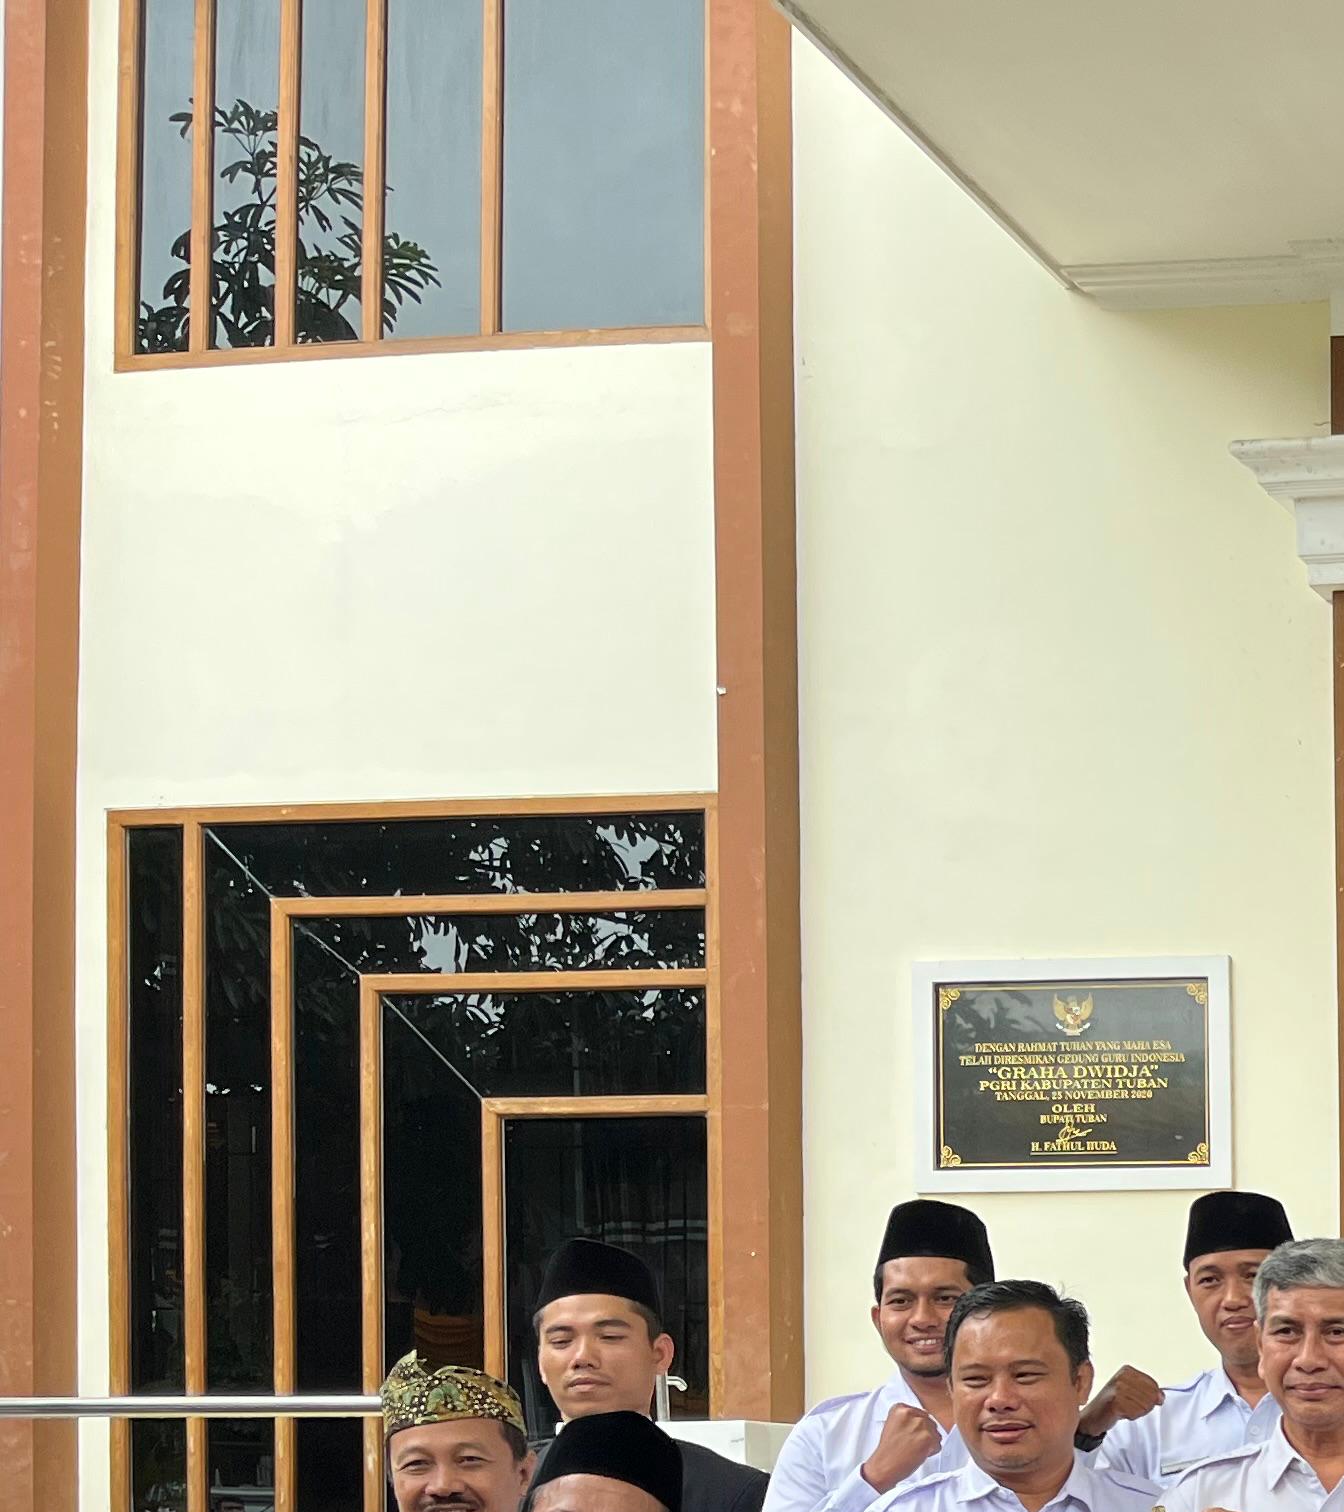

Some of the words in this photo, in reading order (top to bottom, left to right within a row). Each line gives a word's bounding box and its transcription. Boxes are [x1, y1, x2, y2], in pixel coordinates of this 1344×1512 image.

[975, 1043, 1015, 1053] DENGAN
[1018, 1042, 1057, 1052] RAHMAT
[1060, 1042, 1093, 1051] TUHAN
[1095, 1041, 1120, 1051] YANG
[1123, 1041, 1150, 1050] MAHA
[1153, 1040, 1171, 1050] ESA
[959, 1055, 991, 1066] TELAH
[994, 1055, 1054, 1066] DIRESMIKAN
[1101, 1053, 1129, 1064] GURU
[1131, 1053, 1185, 1063] INDONESIA
[980, 1080, 1018, 1091] PGRI
[1021, 1079, 1111, 1090] KABUPATEN
[1118, 1078, 1168, 1089] TUBAN
[1065, 1090, 1129, 1100] NOVEMBER
[1052, 1104, 1095, 1113] OLEH
[1040, 1114, 1074, 1124] BUPATI
[1075, 1114, 1107, 1123] TUBAN
[1045, 1141, 1084, 1151] FATHUL
[1087, 1141, 1116, 1151] HUDA
